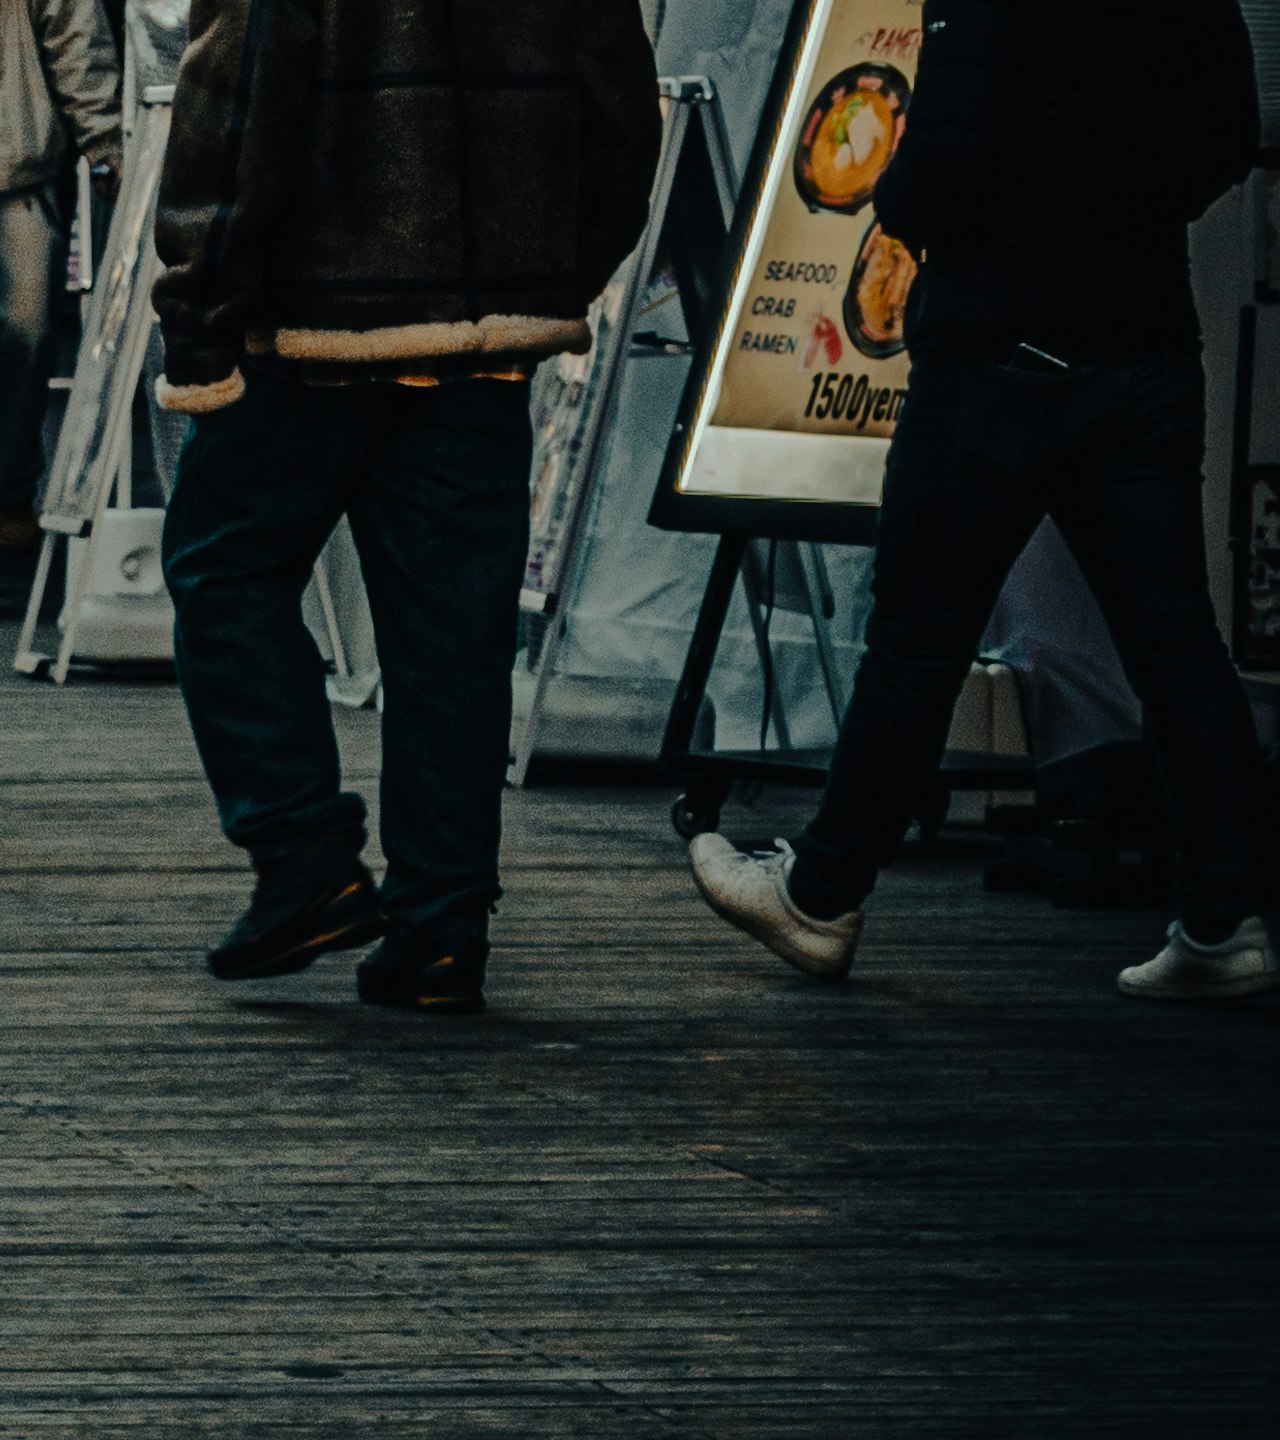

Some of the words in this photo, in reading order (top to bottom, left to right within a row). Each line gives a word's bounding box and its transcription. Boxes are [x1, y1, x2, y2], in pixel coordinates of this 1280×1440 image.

[764, 260, 838, 284] SEAFOOD
[752, 295, 796, 318] CRAB
[739, 331, 799, 355] RAMEN
